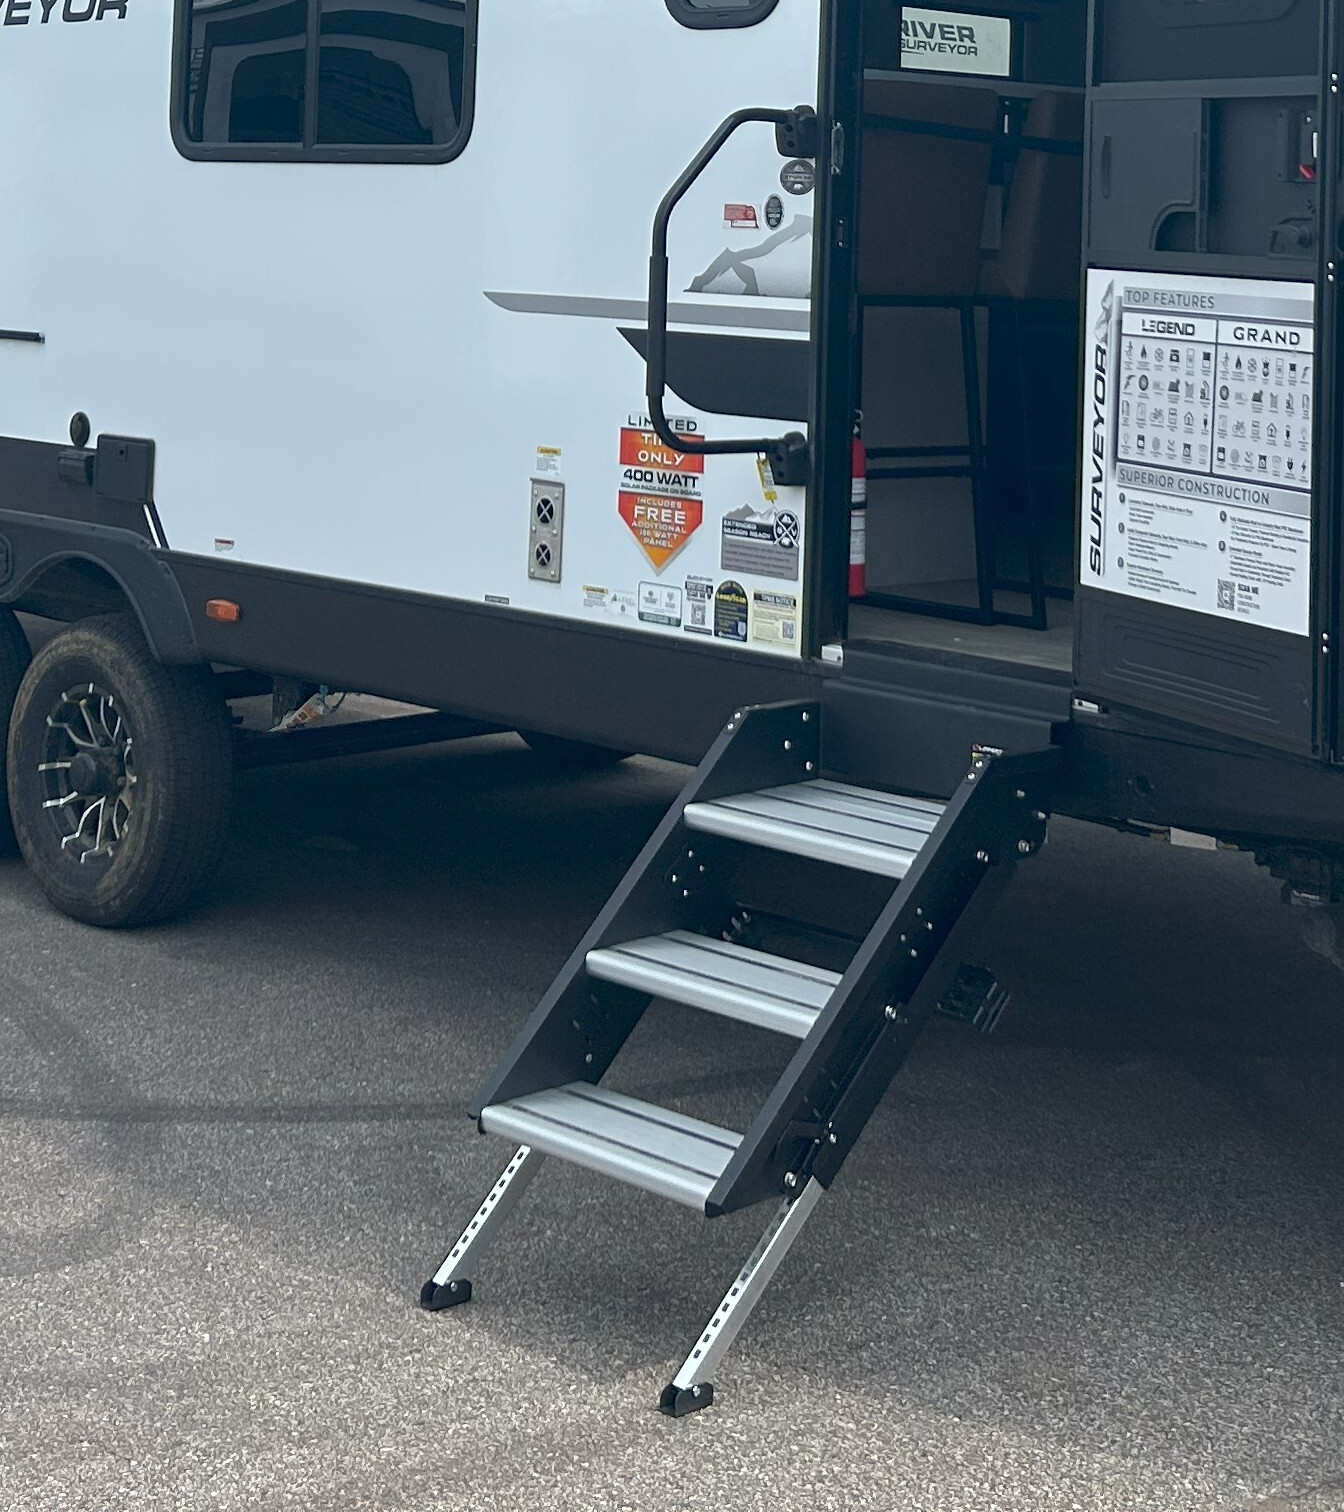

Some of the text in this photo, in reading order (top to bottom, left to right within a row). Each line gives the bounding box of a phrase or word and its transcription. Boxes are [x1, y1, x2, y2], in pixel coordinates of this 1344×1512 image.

[1125, 289, 1215, 310] TOP FEATURES
[1142, 318, 1196, 337] LEGEND
[1233, 326, 1301, 346] GRAND
[627, 414, 698, 432] LIMTED
[637, 449, 685, 466] ONLY
[1089, 343, 1107, 577] SURVEYOR
[623, 469, 699, 488] 400 WATT
[1119, 467, 1270, 506] SUPERIOR CONSTRUCTION
[636, 496, 682, 509] INCLUDES
[634, 504, 686, 525] FREE
[631, 519, 687, 534] ADDITIONAL
[642, 537, 674, 548] PANEL
